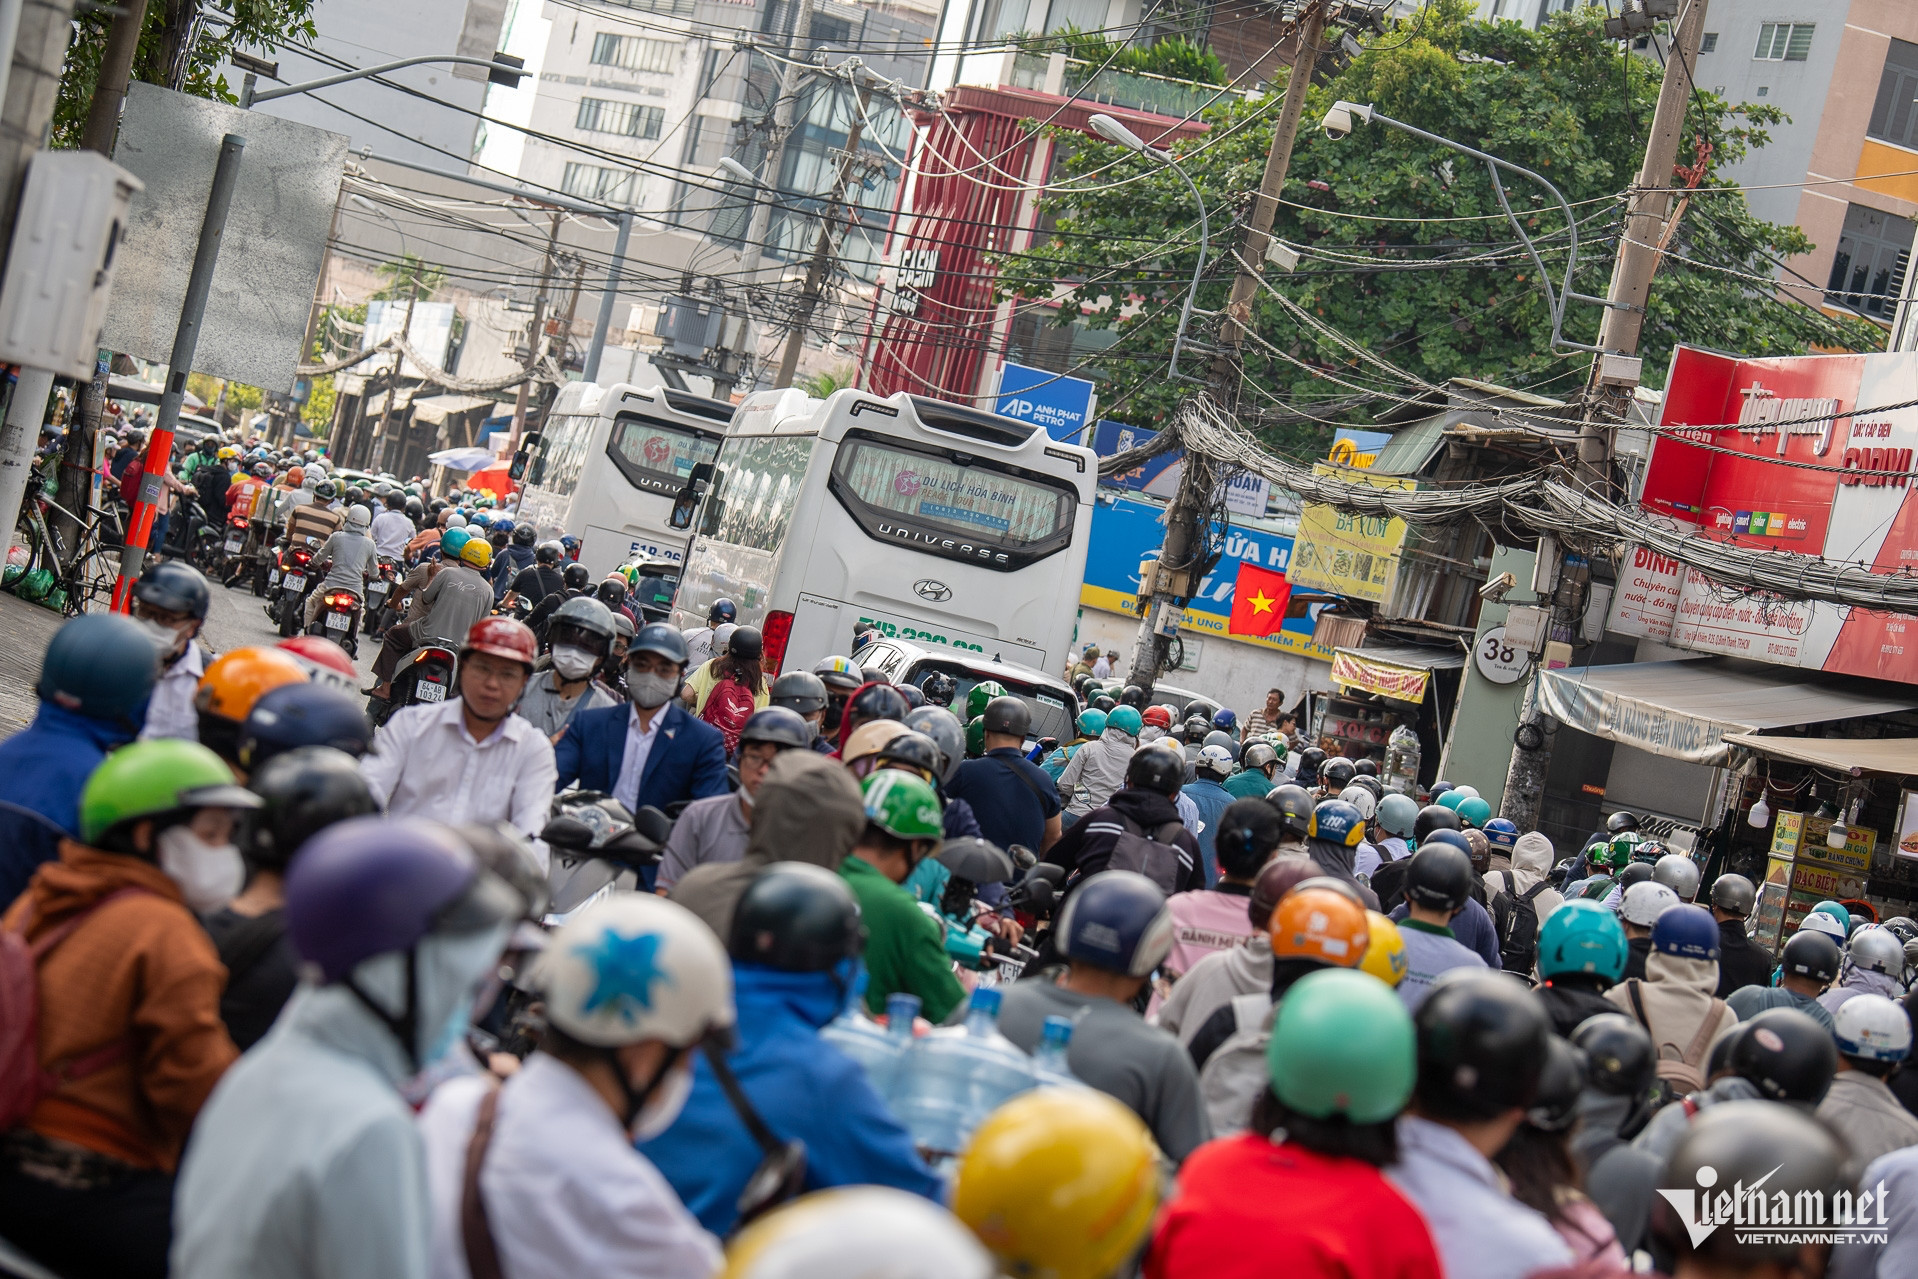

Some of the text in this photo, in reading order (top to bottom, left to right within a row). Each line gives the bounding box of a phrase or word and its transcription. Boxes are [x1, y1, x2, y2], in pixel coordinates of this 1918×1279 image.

[1000, 398, 1032, 417] AP
[1035, 404, 1082, 422] ANH PHAT
[1033, 413, 1065, 427] PETRO
[1776, 398, 1842, 457] quang
[922, 476, 1017, 505] DU LỊCH HÒA BÌNH
[1716, 512, 1807, 531] lighting smart solar home electric
[878, 522, 1009, 565] UNIVERSE
[1633, 577, 1666, 594] Chuyên
[1624, 592, 1647, 604] nước
[1484, 638, 1515, 664] 38
[419, 689, 444, 701] 103.24
[421, 682, 443, 693] 64-AB
[1623, 703, 1650, 741] HÀNG
[1671, 717, 1700, 751] NƯỚC
[1847, 829, 1869, 843] ÔI
[1815, 872, 1837, 894] BIỆT
